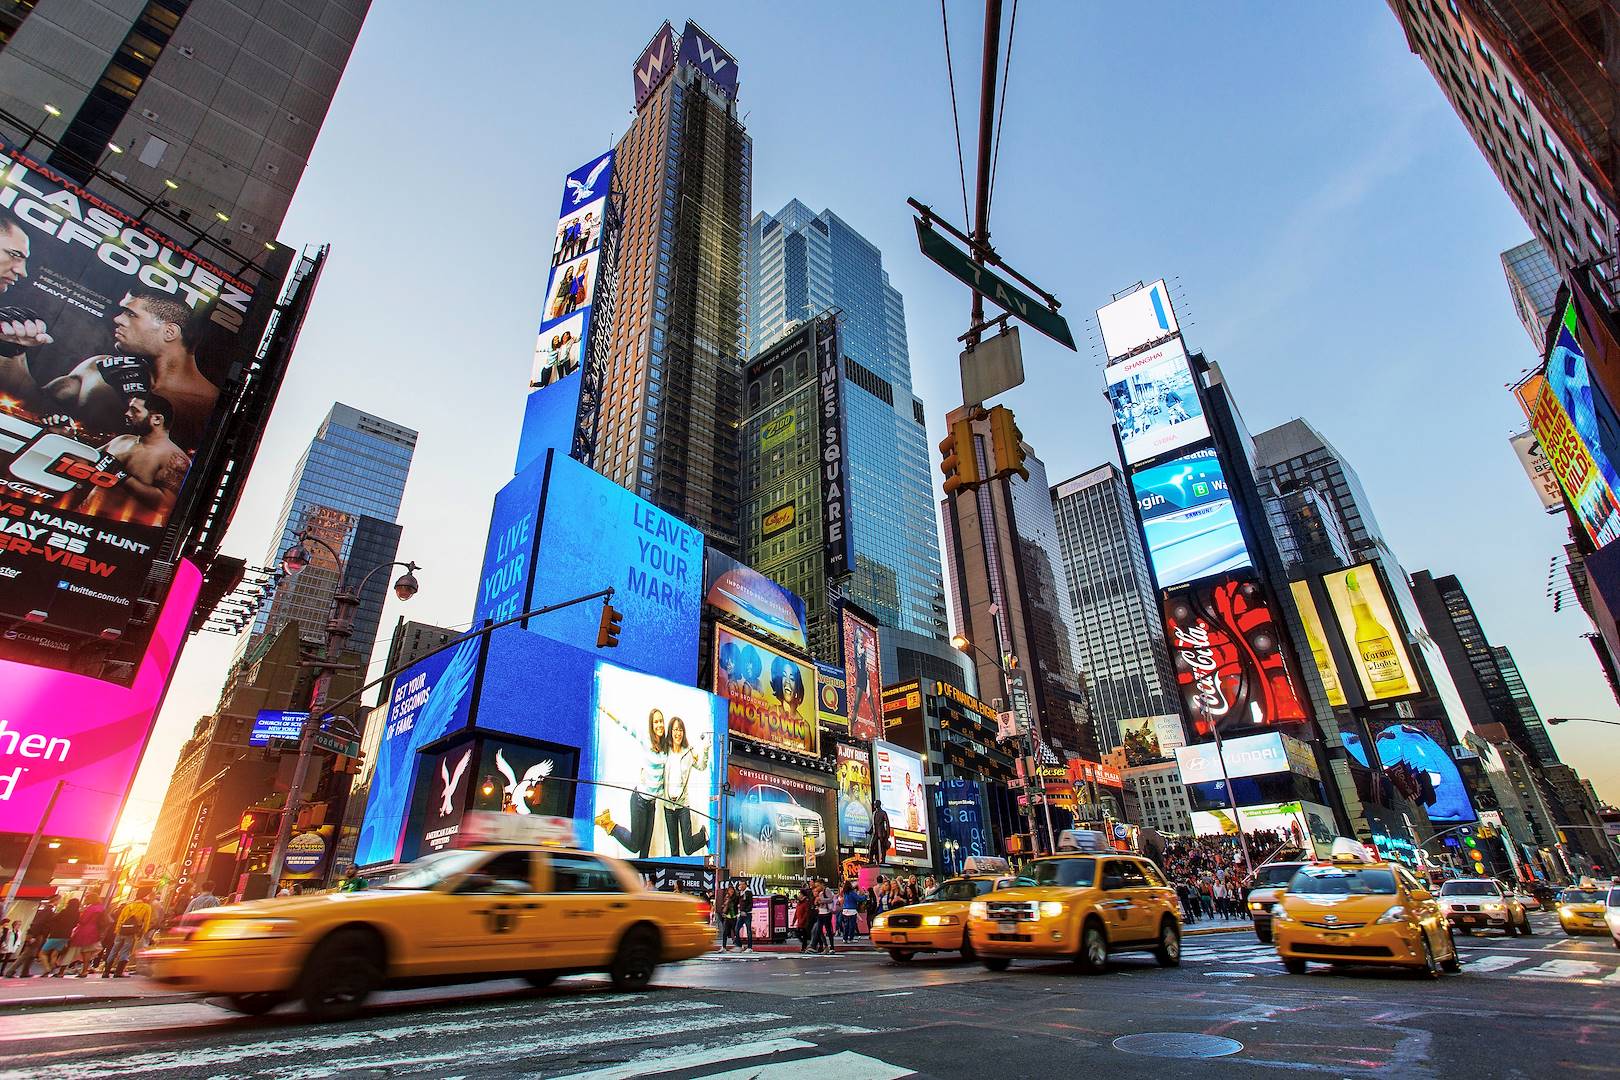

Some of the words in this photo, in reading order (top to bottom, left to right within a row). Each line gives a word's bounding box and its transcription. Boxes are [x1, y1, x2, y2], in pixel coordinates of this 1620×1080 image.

[637, 35, 667, 88] W
[696, 35, 727, 73] W
[9, 150, 141, 227] HEAVYWEIGHT
[143, 227, 254, 294] CHAMPIONSHIP
[33, 281, 67, 299] HEAVY
[67, 298, 104, 317] STAKES
[966, 260, 981, 285] 7
[996, 283, 1027, 315] AV
[821, 335, 836, 418] TIMES
[1124, 351, 1164, 372] SHANGHAI
[1533, 385, 1559, 443] THE
[1175, 449, 1217, 462] eather
[1546, 412, 1567, 459] CROWD
[1554, 428, 1579, 478] GOES
[55, 456, 118, 488] 160
[824, 426, 842, 543] SQUARE
[1565, 447, 1592, 499] WILD!
[30, 510, 94, 538] MARK
[96, 531, 150, 555] HUNT
[47, 531, 88, 555] 25
[497, 513, 532, 562] LIVE
[633, 502, 690, 554] LEAVE
[484, 552, 525, 605] YOUR
[637, 536, 688, 583] YOUR
[830, 554, 843, 563] NYC
[627, 566, 688, 612] MARK
[726, 578, 753, 596] IMPORTED
[1174, 624, 1229, 715] Coca-Cola
[1363, 650, 1394, 661] Corona
[391, 704, 400, 721] 15
[400, 687, 430, 717] SECONDS
[395, 683, 408, 703] GET
[408, 672, 426, 695] YOUR
[822, 684, 838, 712] Q
[386, 723, 396, 740] OF
[395, 713, 414, 736] FAME
[729, 701, 805, 739] MOTOWN
[314, 735, 349, 751] roadway
[739, 769, 768, 780] CHRYSLER
[782, 779, 804, 789] MOTOWN
[805, 784, 825, 794] EDITION
